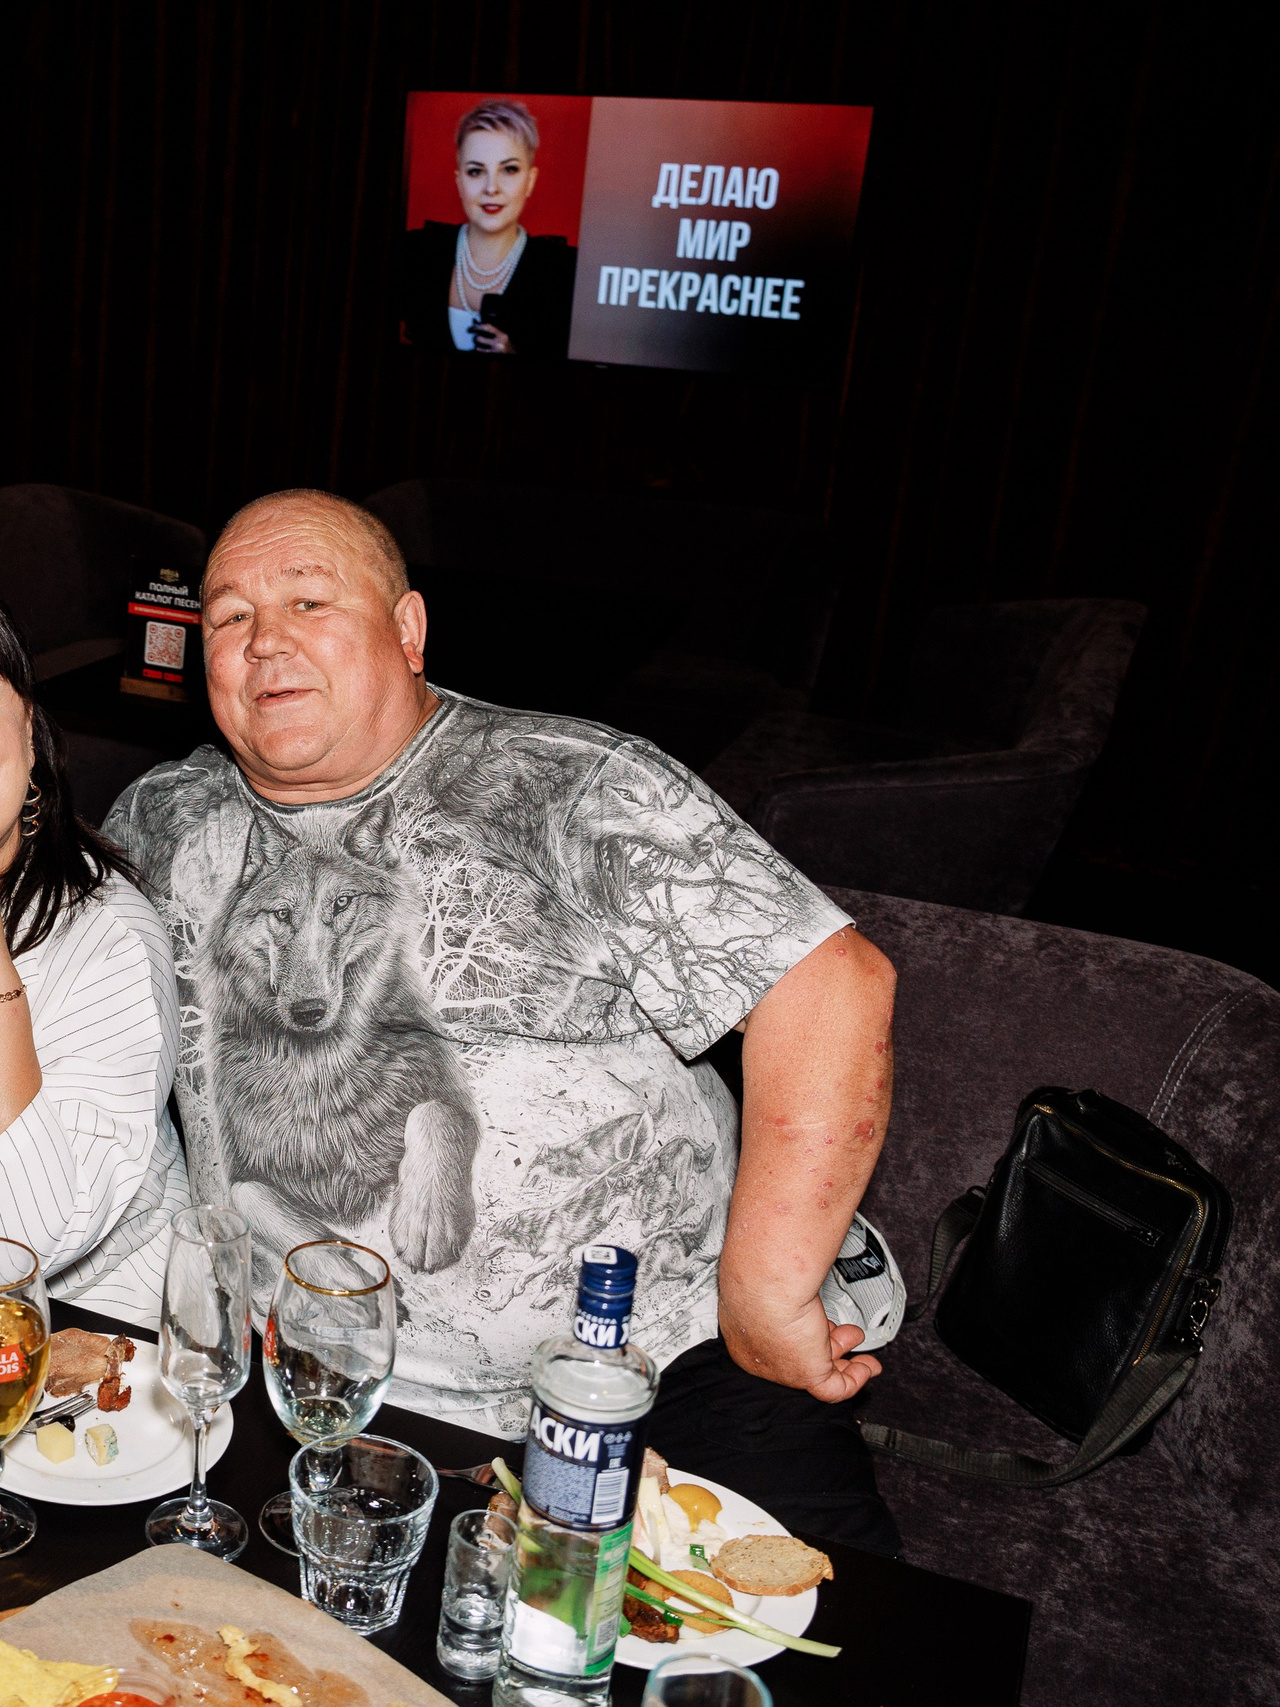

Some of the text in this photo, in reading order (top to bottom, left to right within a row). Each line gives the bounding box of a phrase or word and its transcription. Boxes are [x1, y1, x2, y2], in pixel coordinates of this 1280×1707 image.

[651, 162, 780, 210] ДЕЛАЮ
[676, 217, 752, 262] МИР
[596, 265, 805, 321] ПРЕКРАСНЕЕ
[135, 591, 172, 604] КАТАЛОГ
[149, 582, 188, 596] ПОЛНЫЙ
